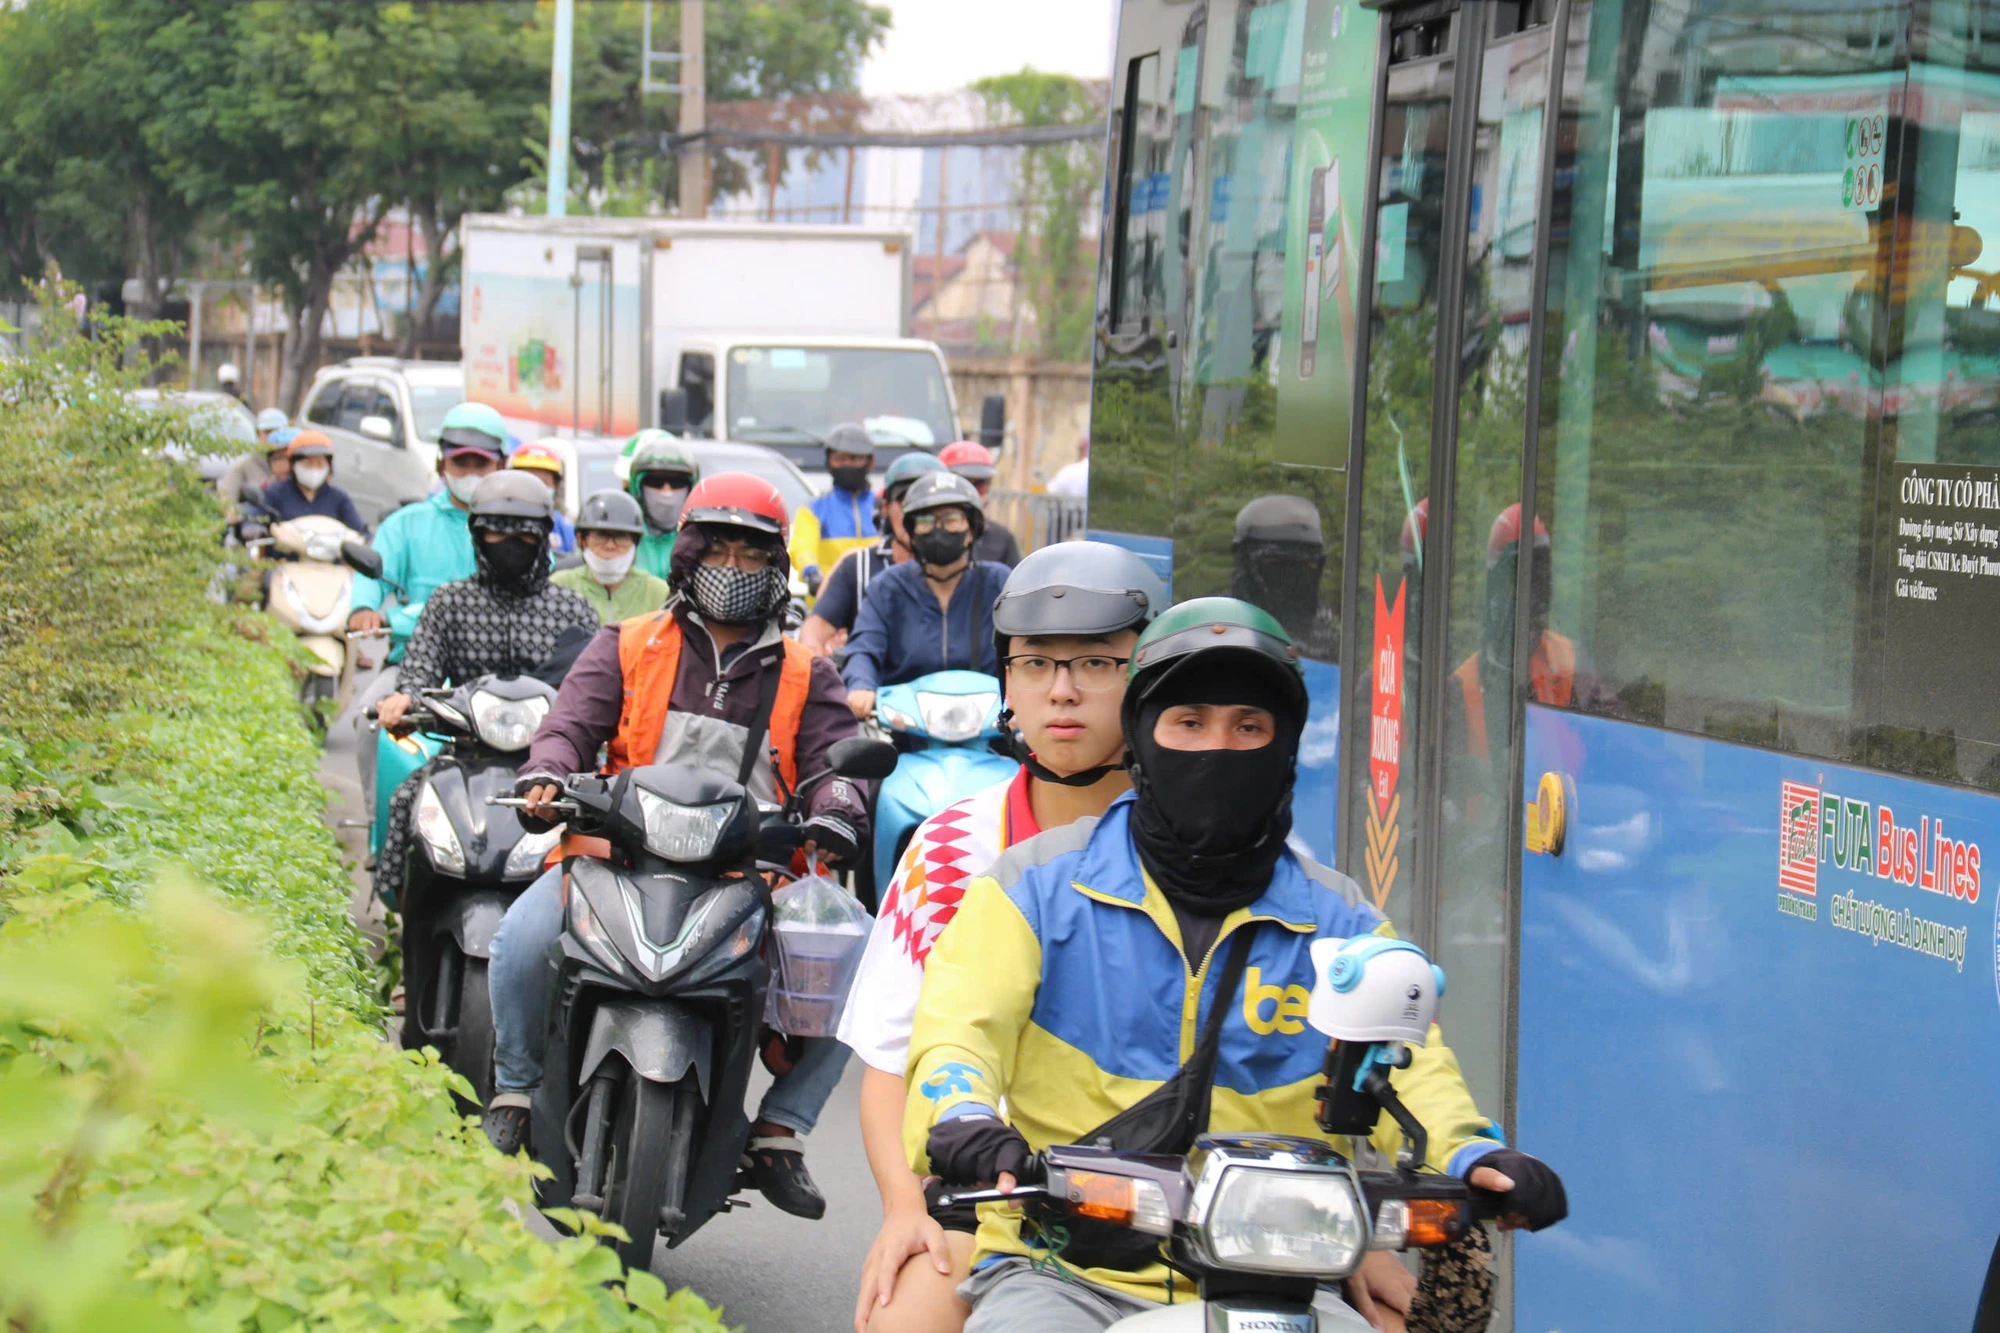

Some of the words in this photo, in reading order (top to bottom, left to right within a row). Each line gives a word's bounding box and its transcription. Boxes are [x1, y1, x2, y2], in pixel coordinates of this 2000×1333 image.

[1902, 469, 1935, 506] CÔNG
[1937, 479, 1954, 506] TY
[1955, 472, 1973, 508] CỔ
[1922, 519, 1935, 543] dây
[1935, 519, 1953, 545] nóng
[1954, 521, 1964, 541] Sở
[1964, 522, 1979, 547] Xây
[1896, 578, 1909, 597] Giá
[1927, 550, 1950, 571] CSKH
[1950, 553, 1961, 573] Xe
[1961, 554, 1979, 579] Buýt
[1372, 700, 1399, 765] XUỐNG
[1819, 792, 1874, 876] FUTA
[1877, 805, 1918, 887] Bus
[1919, 814, 1980, 904] Lines
[1831, 889, 1859, 932] CHẤT
[1858, 900, 1897, 947] LƯỢNG
[1897, 907, 1913, 949] LÀ
[1912, 917, 1947, 959] DANH
[1946, 926, 1967, 973] DỰ
[1242, 966, 1311, 1036] be
